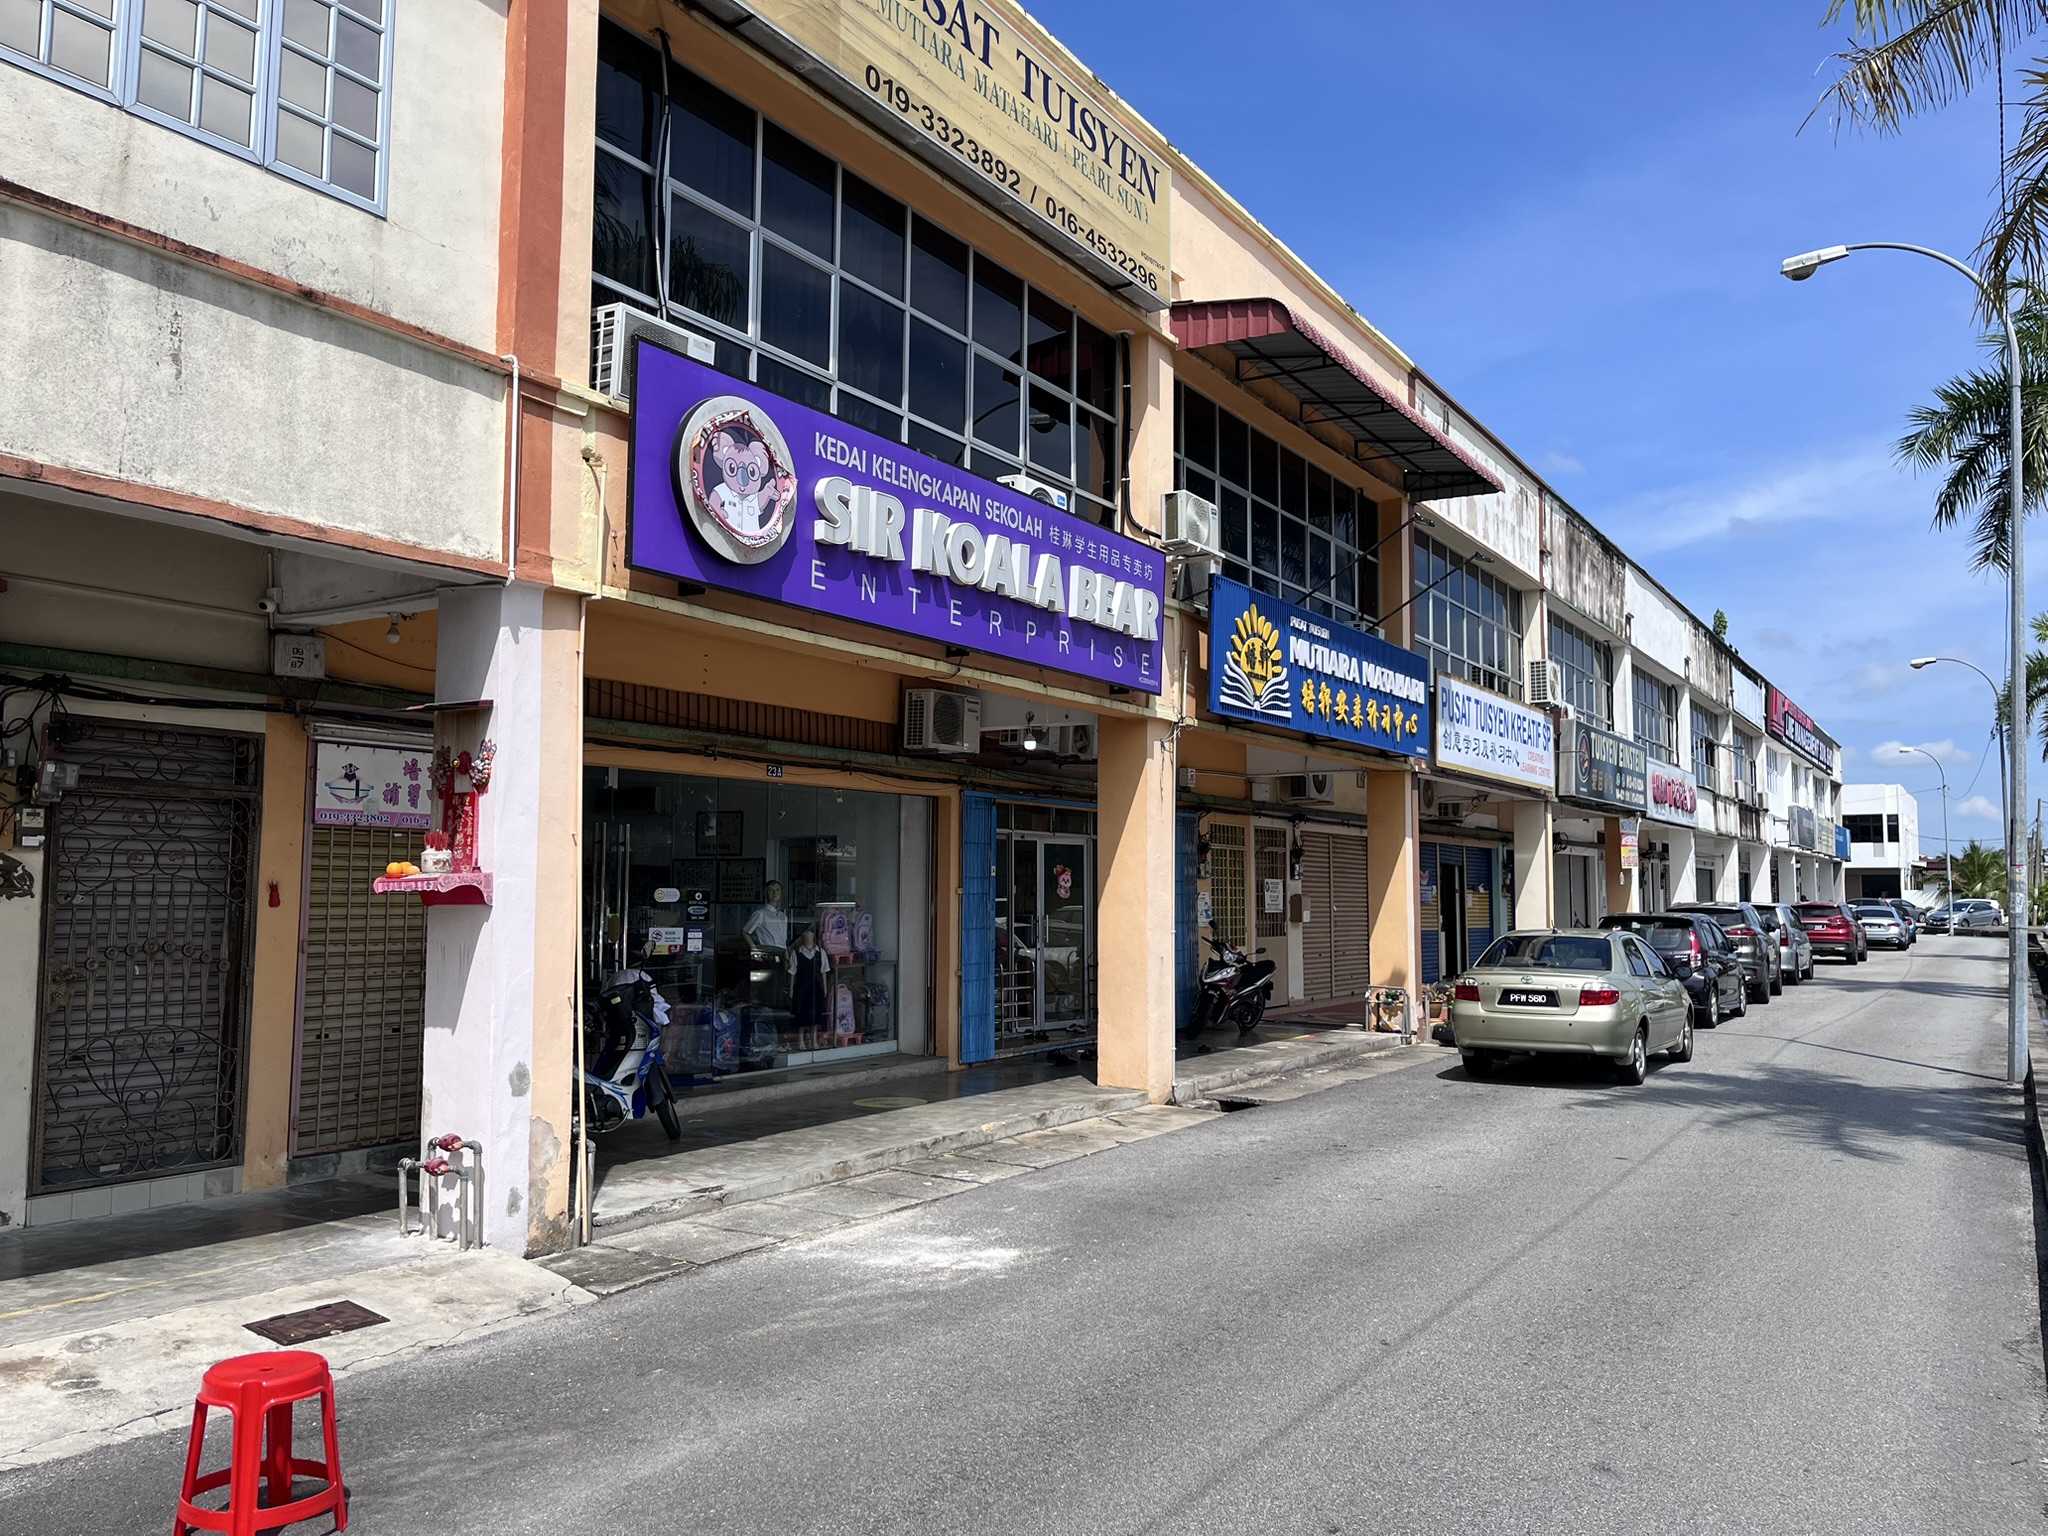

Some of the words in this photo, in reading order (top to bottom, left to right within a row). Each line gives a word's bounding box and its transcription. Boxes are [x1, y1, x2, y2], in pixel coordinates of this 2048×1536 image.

[1016, 48, 1160, 206] TUISYEN
[865, 64, 1021, 195] 019-3323892
[1045, 196, 1159, 292] 016-4532296
[815, 431, 867, 474] KEDAI
[872, 453, 981, 516] KELENGKAPAN
[985, 498, 1043, 540] SEKOLAH
[1049, 524, 1153, 582] 桂琳学生用品专卖坊
[814, 476, 906, 561] SIR
[911, 508, 1066, 613] KOALA
[1068, 564, 1160, 641] BEAR
[810, 559, 1150, 675] ENTERPRISE
[291, 660, 303, 669] 87
[1289, 635, 1360, 684] MUTIARA
[1361, 660, 1425, 704] MATAHARI
[1441, 686, 1471, 727] PUSAT
[1474, 698, 1509, 739] TUISYEN
[1510, 711, 1541, 748] KREATIF
[1542, 723, 1551, 752] SP
[1442, 728, 1520, 768] 创意学习及补习中心
[1590, 732, 1618, 765] TUISYEN
[767, 765, 782, 777] 23A
[319, 811, 390, 824] 019-3323892
[1509, 993, 1527, 1002] PFW
[1527, 994, 1547, 1003] 5610
